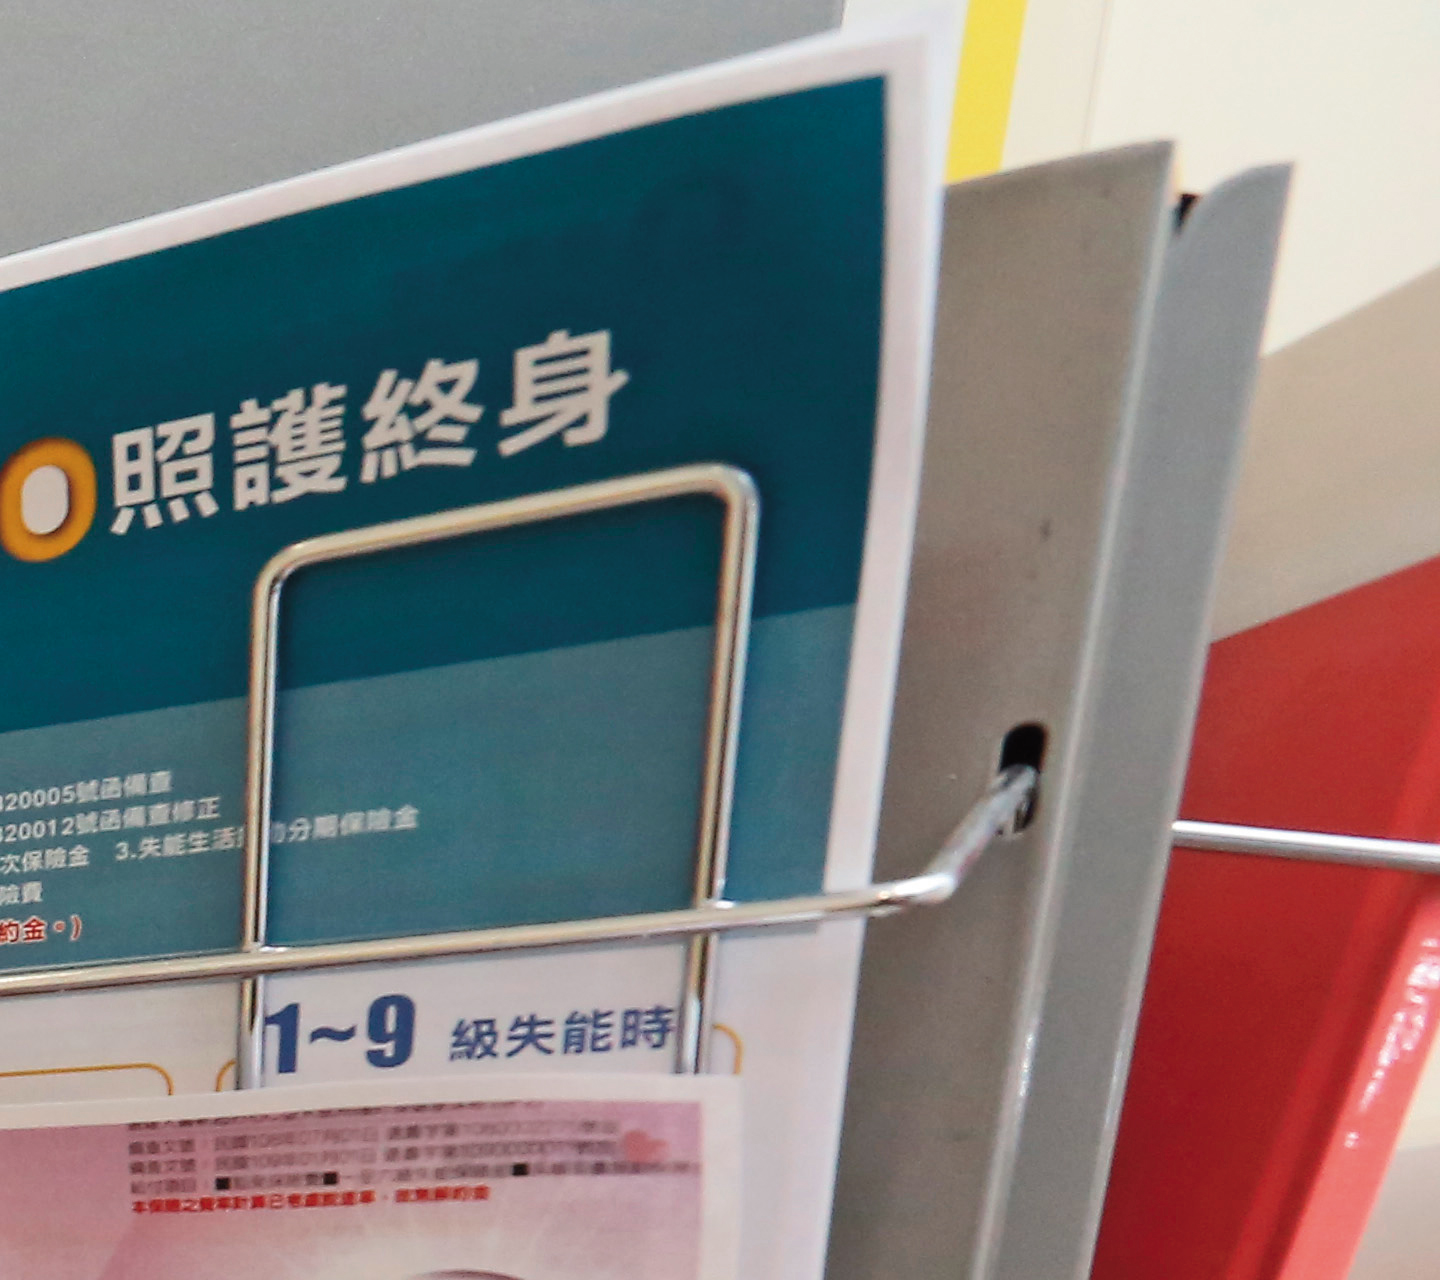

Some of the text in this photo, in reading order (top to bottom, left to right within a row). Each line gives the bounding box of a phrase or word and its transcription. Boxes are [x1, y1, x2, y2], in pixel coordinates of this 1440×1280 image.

[264, 994, 676, 1073] 1~9 級失能時
